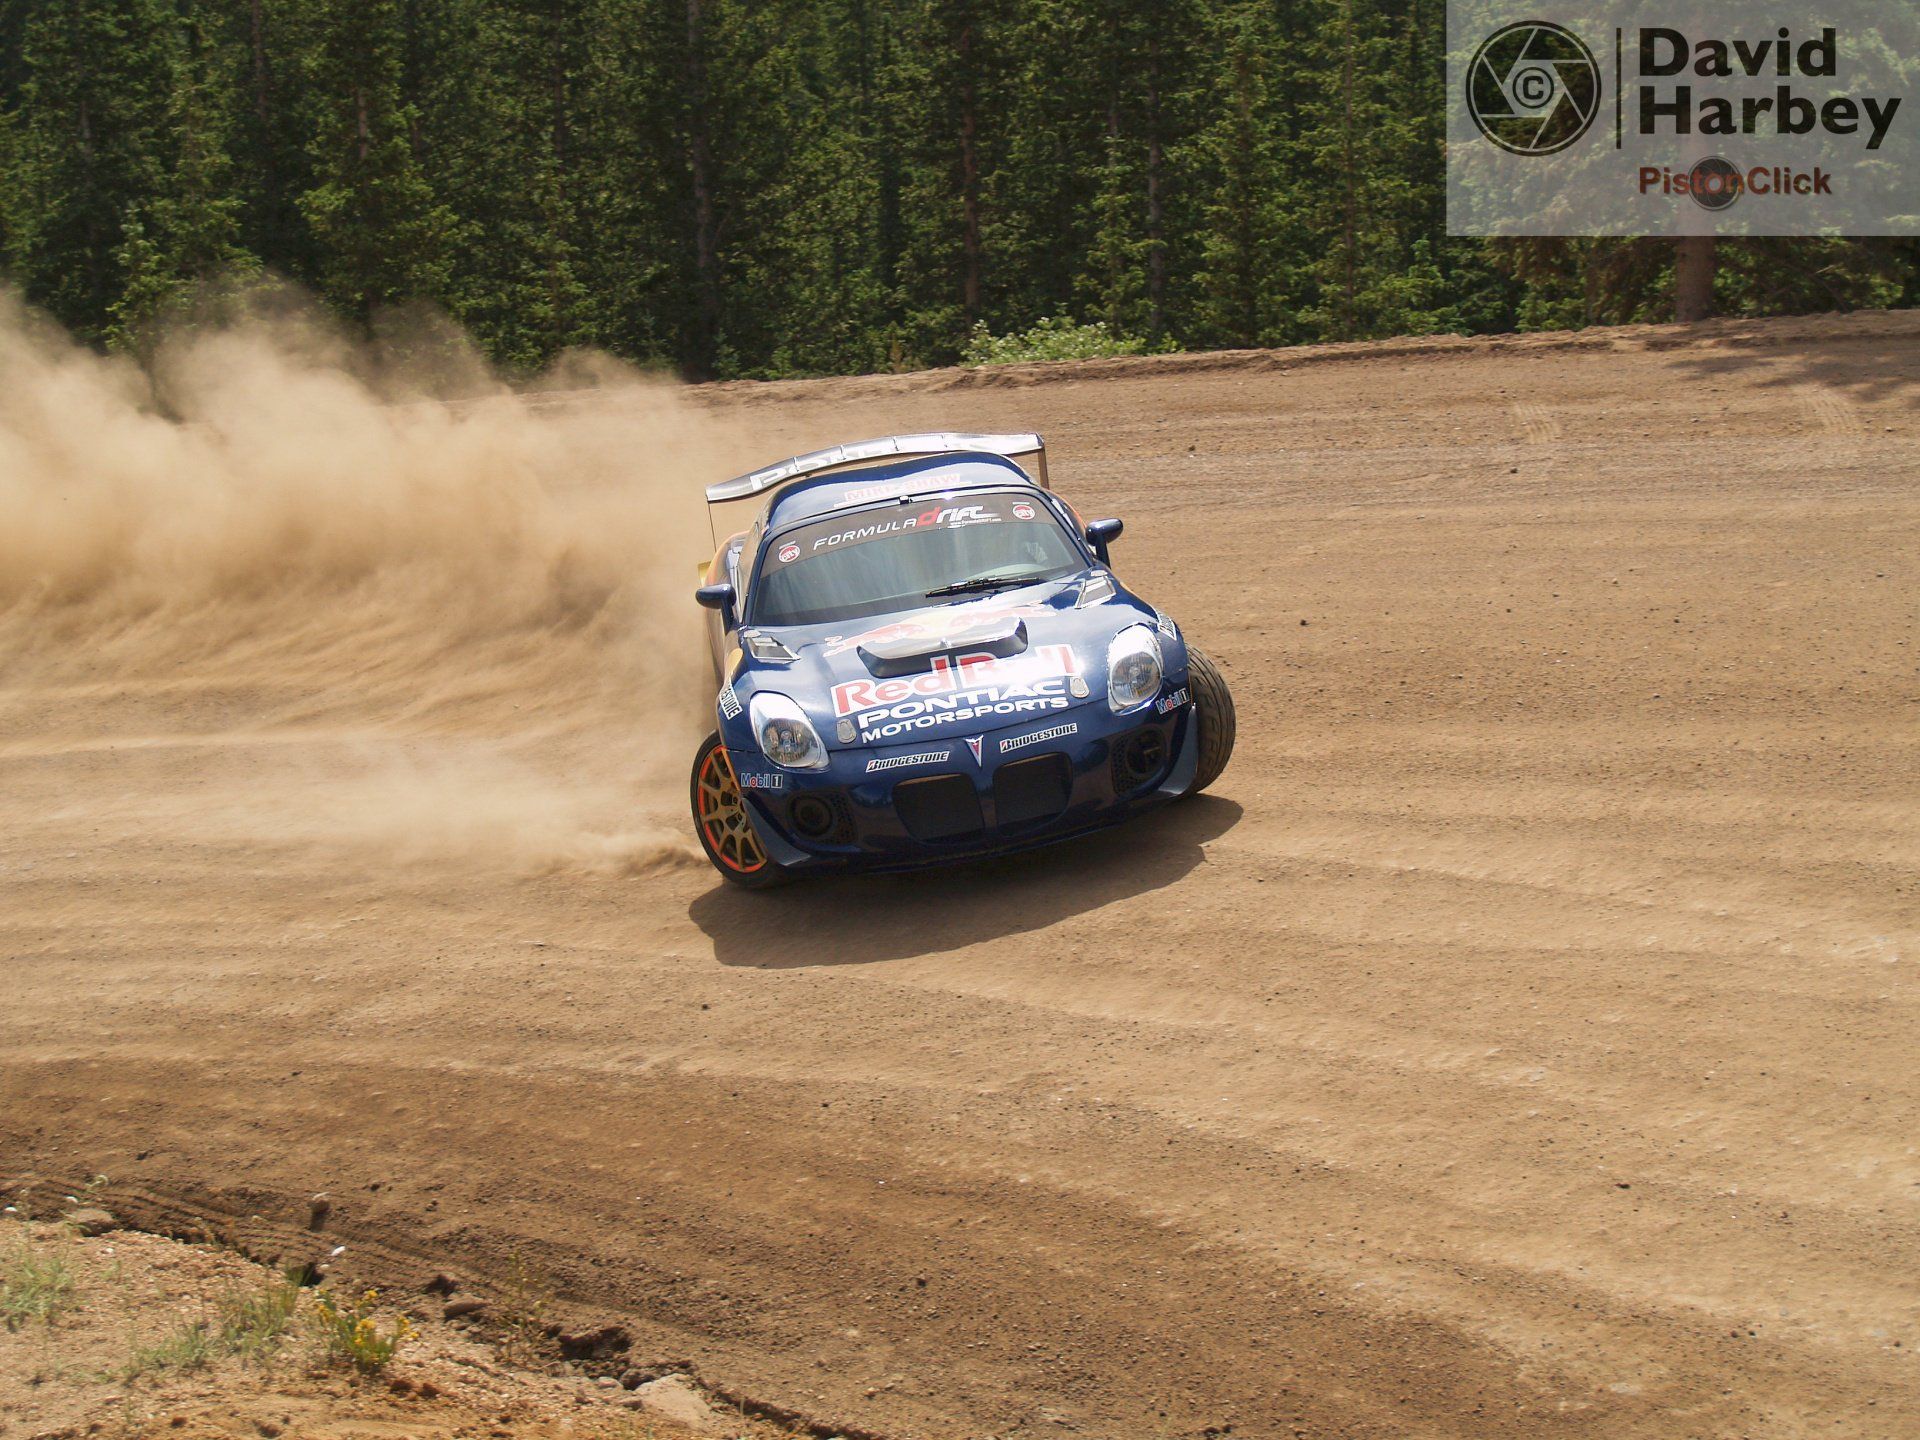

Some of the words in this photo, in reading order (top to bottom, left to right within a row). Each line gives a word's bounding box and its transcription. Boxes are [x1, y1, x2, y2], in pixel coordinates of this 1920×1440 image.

[831, 655, 957, 717] Red
[956, 644, 1077, 688] Bll
[857, 679, 1066, 729] PONTIAC
[1155, 690, 1181, 714] Mobil
[861, 697, 1069, 744] MOTORSPORTS
[1000, 723, 1077, 753] BRIDGESTONE
[866, 751, 950, 773] BRIDGESTONE
[741, 772, 770, 788] Mobil
[771, 774, 783, 789] 1
